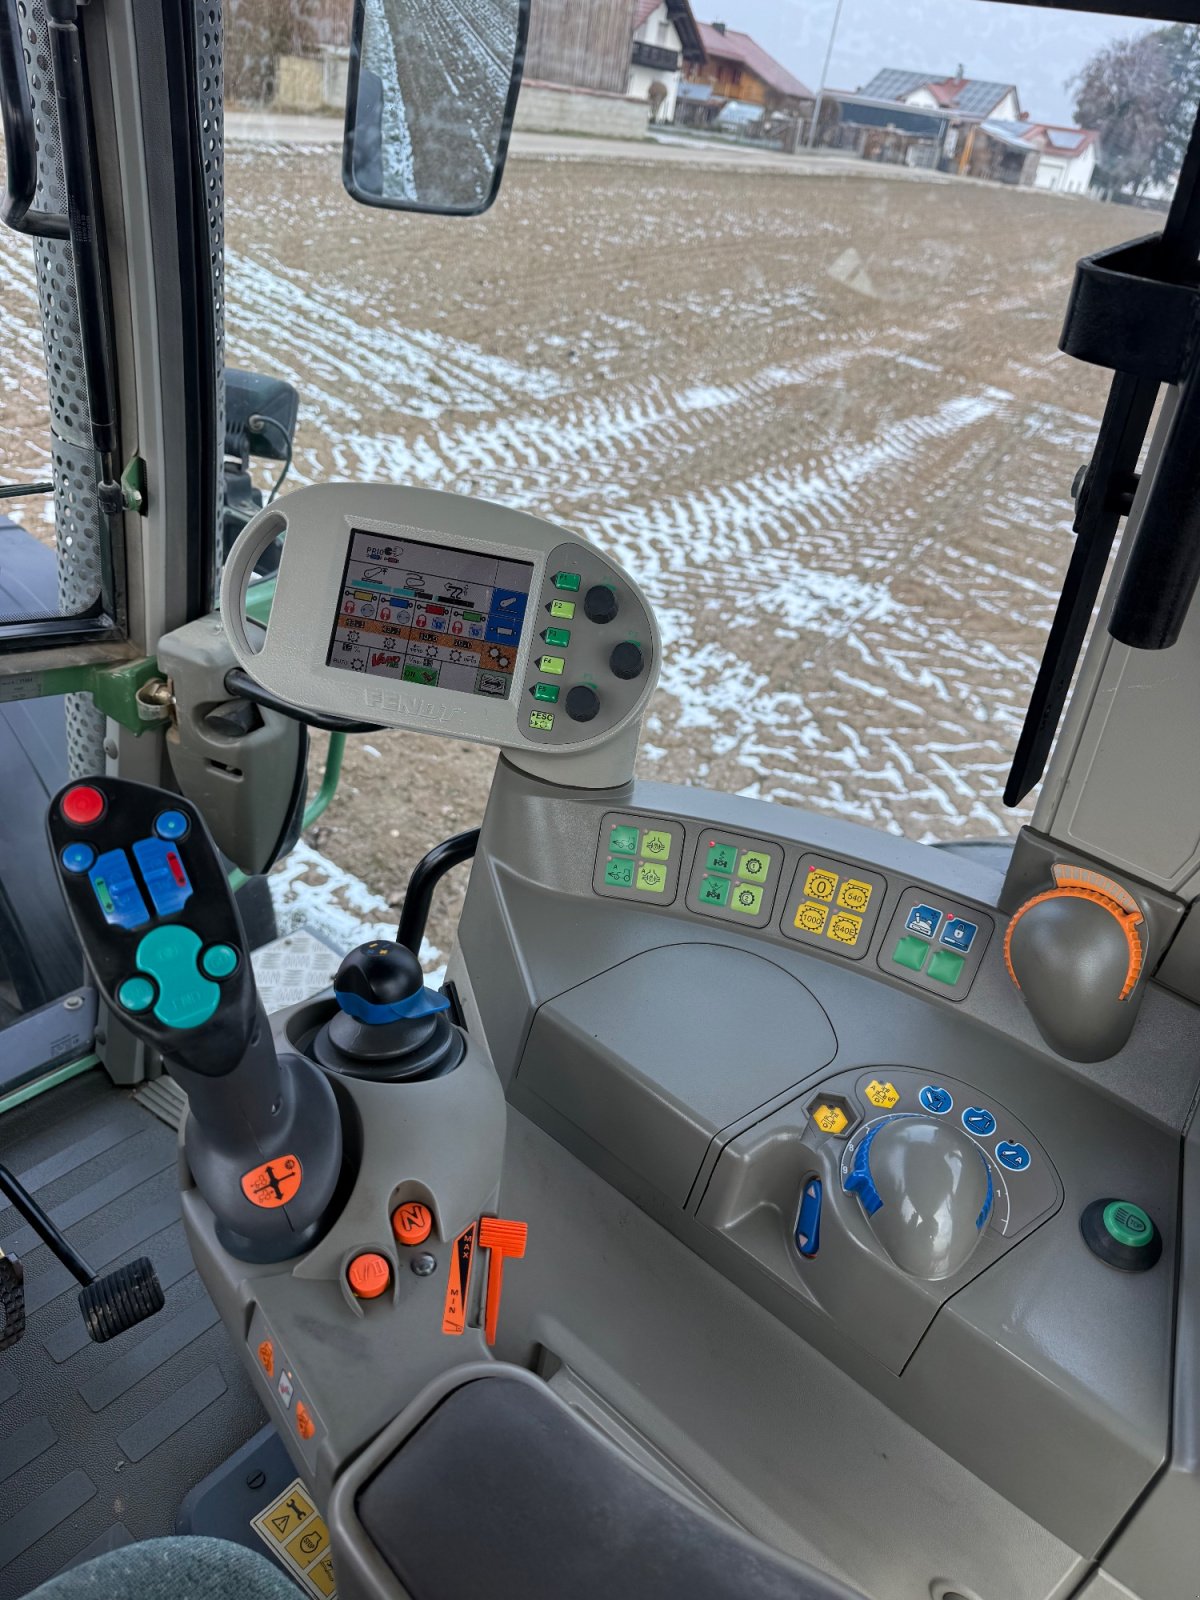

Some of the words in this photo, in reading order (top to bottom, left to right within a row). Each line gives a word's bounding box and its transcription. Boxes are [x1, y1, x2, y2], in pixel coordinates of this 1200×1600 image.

[366, 546, 384, 556] PRIO
[549, 629, 557, 637] F3
[536, 713, 553, 722] ESC
[816, 881, 827, 894] 0
[847, 893, 863, 903] 540
[803, 914, 822, 926] 1000
[835, 925, 855, 936] 540E
[849, 1144, 855, 1152] 8
[1015, 1157, 1023, 1165] A
[842, 1166, 849, 1174] 9
[401, 1206, 426, 1231] N
[1129, 1218, 1144, 1231] TOP
[463, 1235, 473, 1258] MAX
[449, 1289, 459, 1313] MIN
[303, 1537, 315, 1549] STOP
